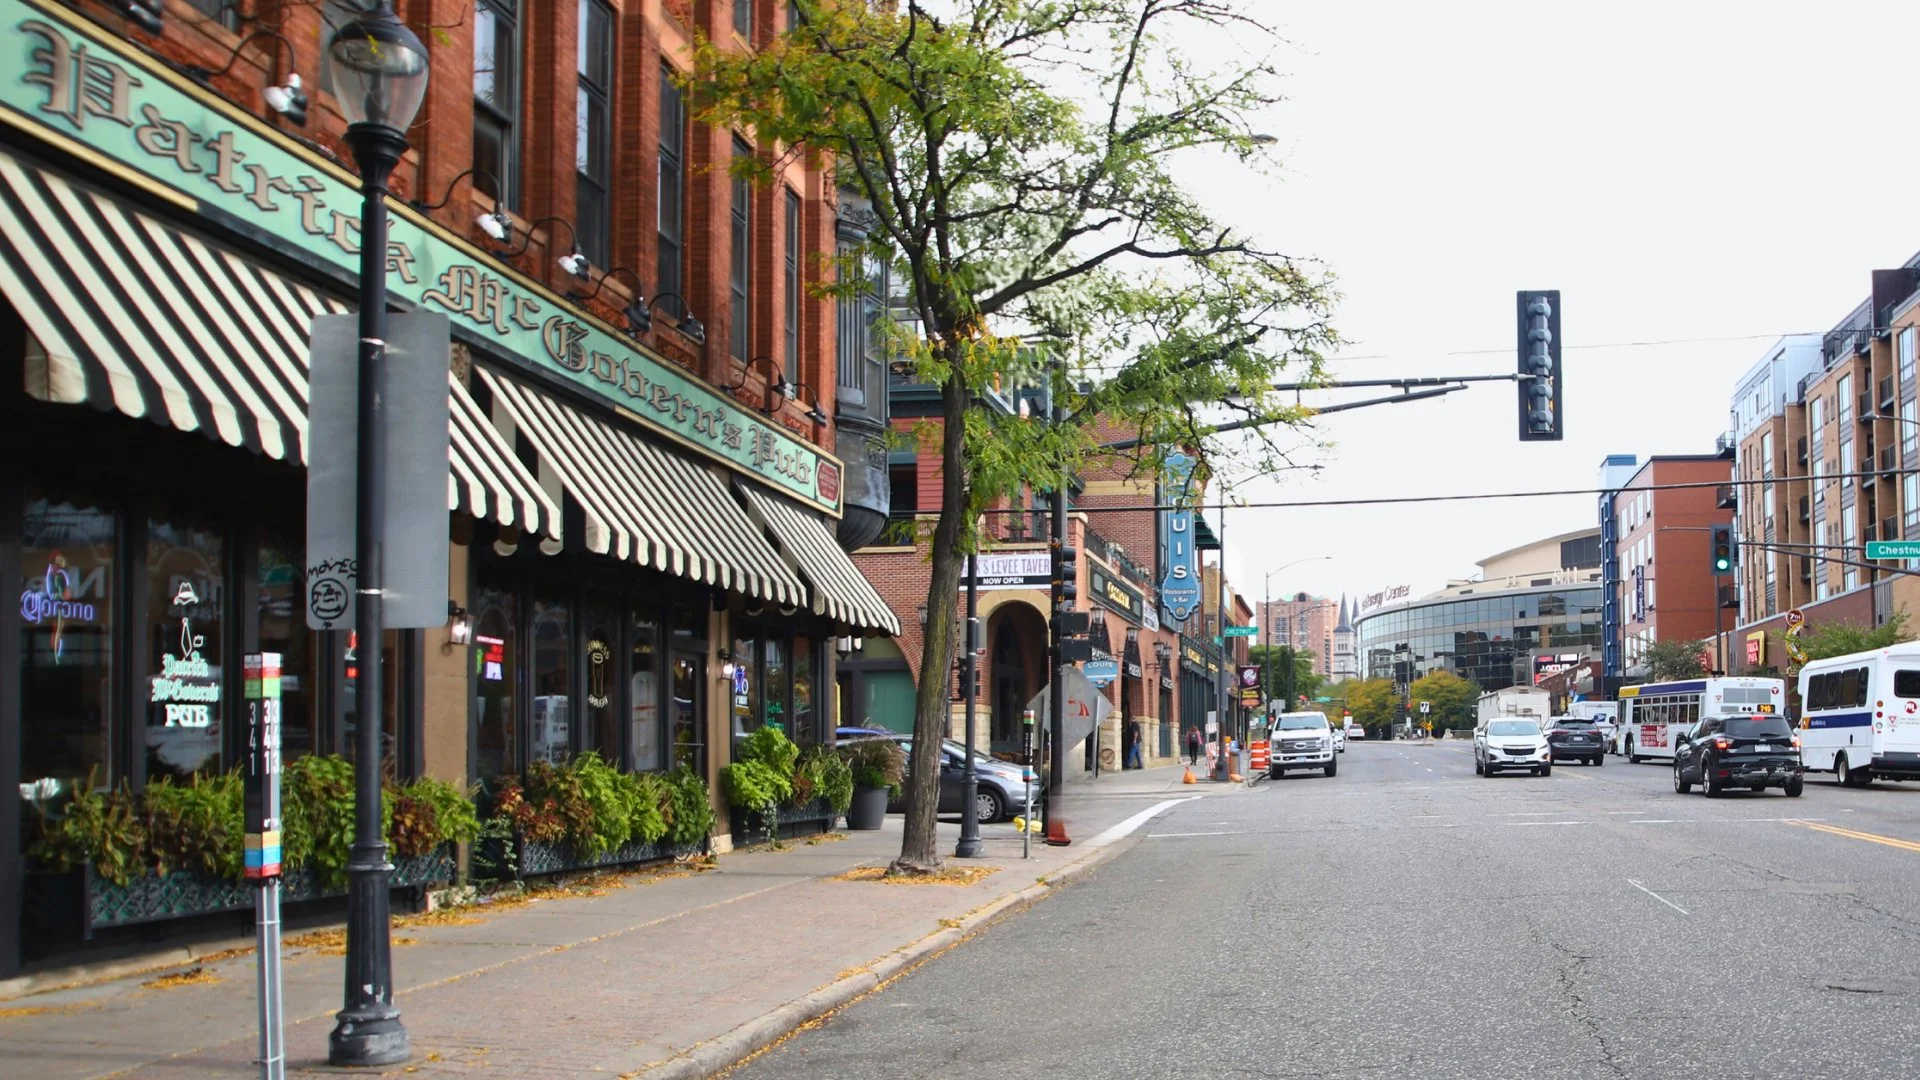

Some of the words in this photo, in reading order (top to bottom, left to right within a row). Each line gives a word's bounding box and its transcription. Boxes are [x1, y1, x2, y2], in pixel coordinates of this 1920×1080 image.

[17, 19, 418, 285] Patrick
[422, 265, 742, 451] McGovern's
[748, 422, 812, 486] Pub
[992, 558, 1019, 575] LEVEE
[1022, 558, 1051, 574] TAVER
[982, 577, 1001, 585] NOW
[1002, 576, 1024, 584] OPEN
[1385, 584, 1411, 601] Center
[20, 589, 94, 624] Corona
[1087, 660, 1114, 669] LOUIS
[164, 704, 210, 728] PUB
